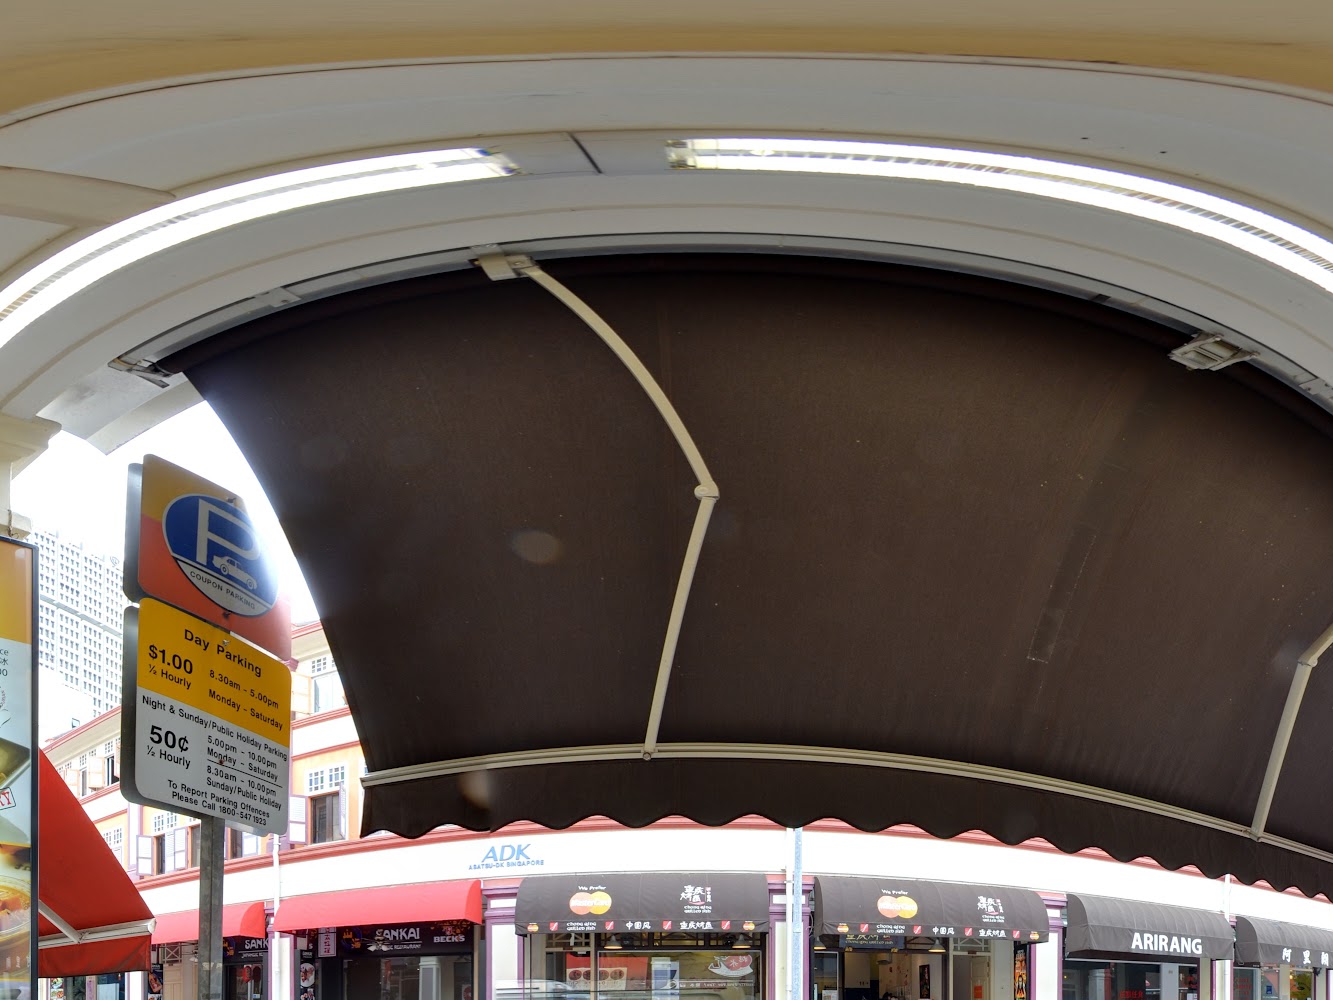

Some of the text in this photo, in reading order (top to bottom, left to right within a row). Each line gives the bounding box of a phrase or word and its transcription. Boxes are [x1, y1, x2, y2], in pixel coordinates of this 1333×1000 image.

[190, 571, 255, 610] COUPON PARKING
[148, 644, 193, 675] $1.00
[184, 629, 261, 677] Day Parking
[161, 669, 191, 689] Hourly
[209, 669, 279, 709] 8.30am 5.00pm
[209, 689, 283, 731] Monday Saturday
[142, 695, 166, 712] Night
[169, 705, 176, 715] &
[236, 732, 262, 750] Holiday
[263, 743, 288, 762] Parking
[149, 725, 189, 752] 50¢
[159, 749, 191, 769] Hourly
[207, 735, 277, 770] 5.00pm 10.00pm
[207, 747, 278, 782] Monday Saturday
[207, 765, 277, 797] 8.30am 10.00pm
[168, 779, 270, 818] To Report Parking Offences
[172, 791, 216, 811] Please Call
[259, 794, 282, 811] Holiday
[468, 859, 544, 870] ASATSU-DK SINGAPORE
[481, 843, 531, 863] ADK
[433, 934, 465, 943] BECK'S
[1131, 932, 1202, 955] ARIRANG
